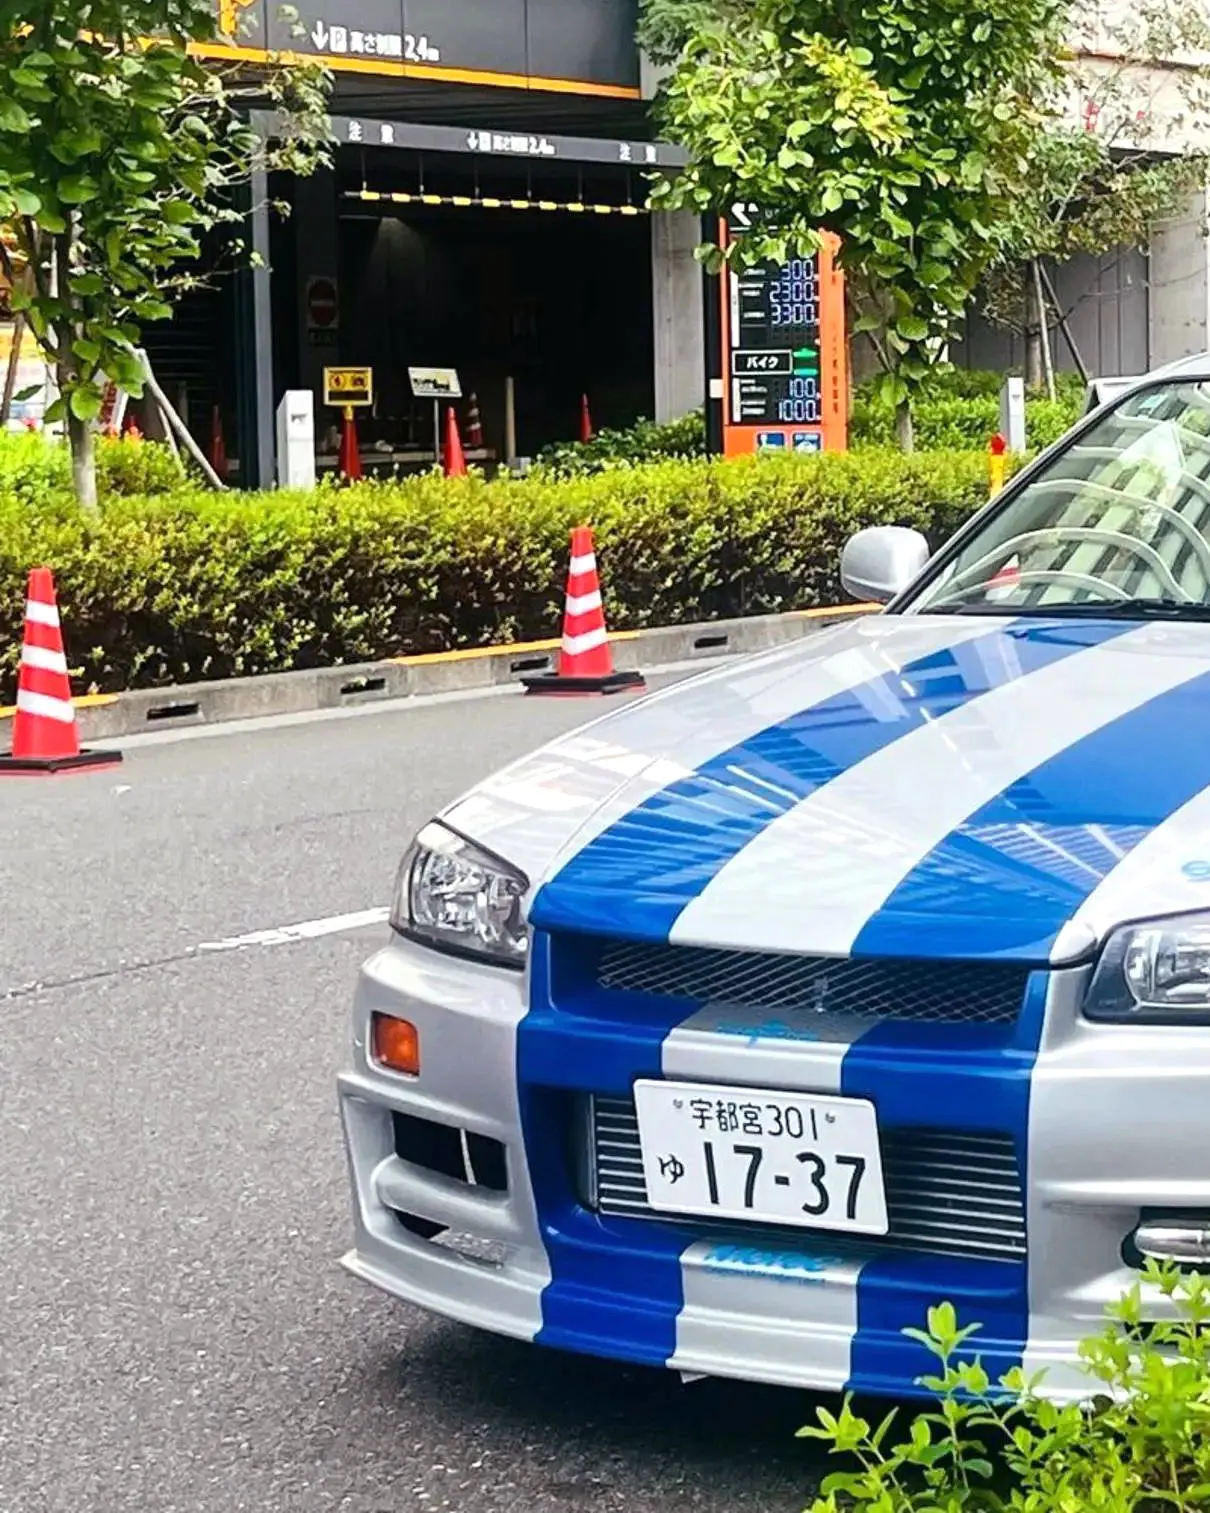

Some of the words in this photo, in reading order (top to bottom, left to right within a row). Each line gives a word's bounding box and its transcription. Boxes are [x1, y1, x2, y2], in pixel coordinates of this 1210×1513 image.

[769, 281, 815, 303] 2300
[771, 303, 815, 325] 3300
[746, 355, 779, 369] バイク
[789, 377, 816, 399] 100
[779, 399, 817, 421] 1000
[689, 1098, 818, 1141] 宇都宮301
[657, 1153, 685, 1184] ゆ
[703, 1141, 866, 1220] 17-37
